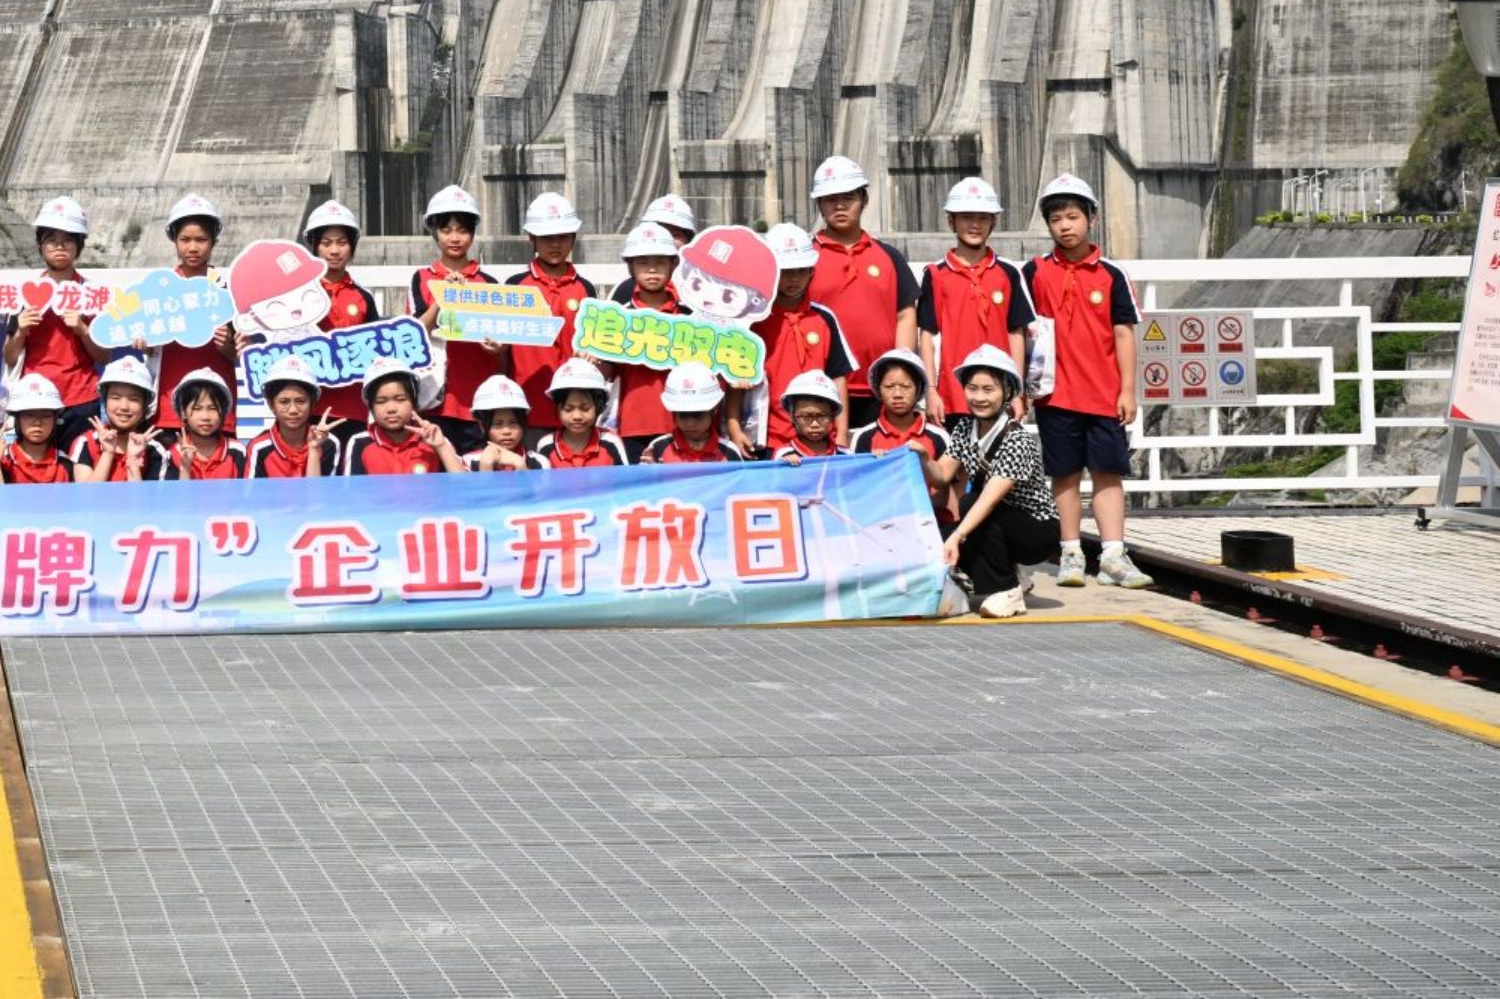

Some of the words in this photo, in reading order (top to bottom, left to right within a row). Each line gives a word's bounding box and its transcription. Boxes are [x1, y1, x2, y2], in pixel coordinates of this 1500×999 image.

[56, 285, 111, 311] 龙滩
[143, 289, 220, 317] 同心聚力
[443, 288, 535, 308] 提供绿色能源
